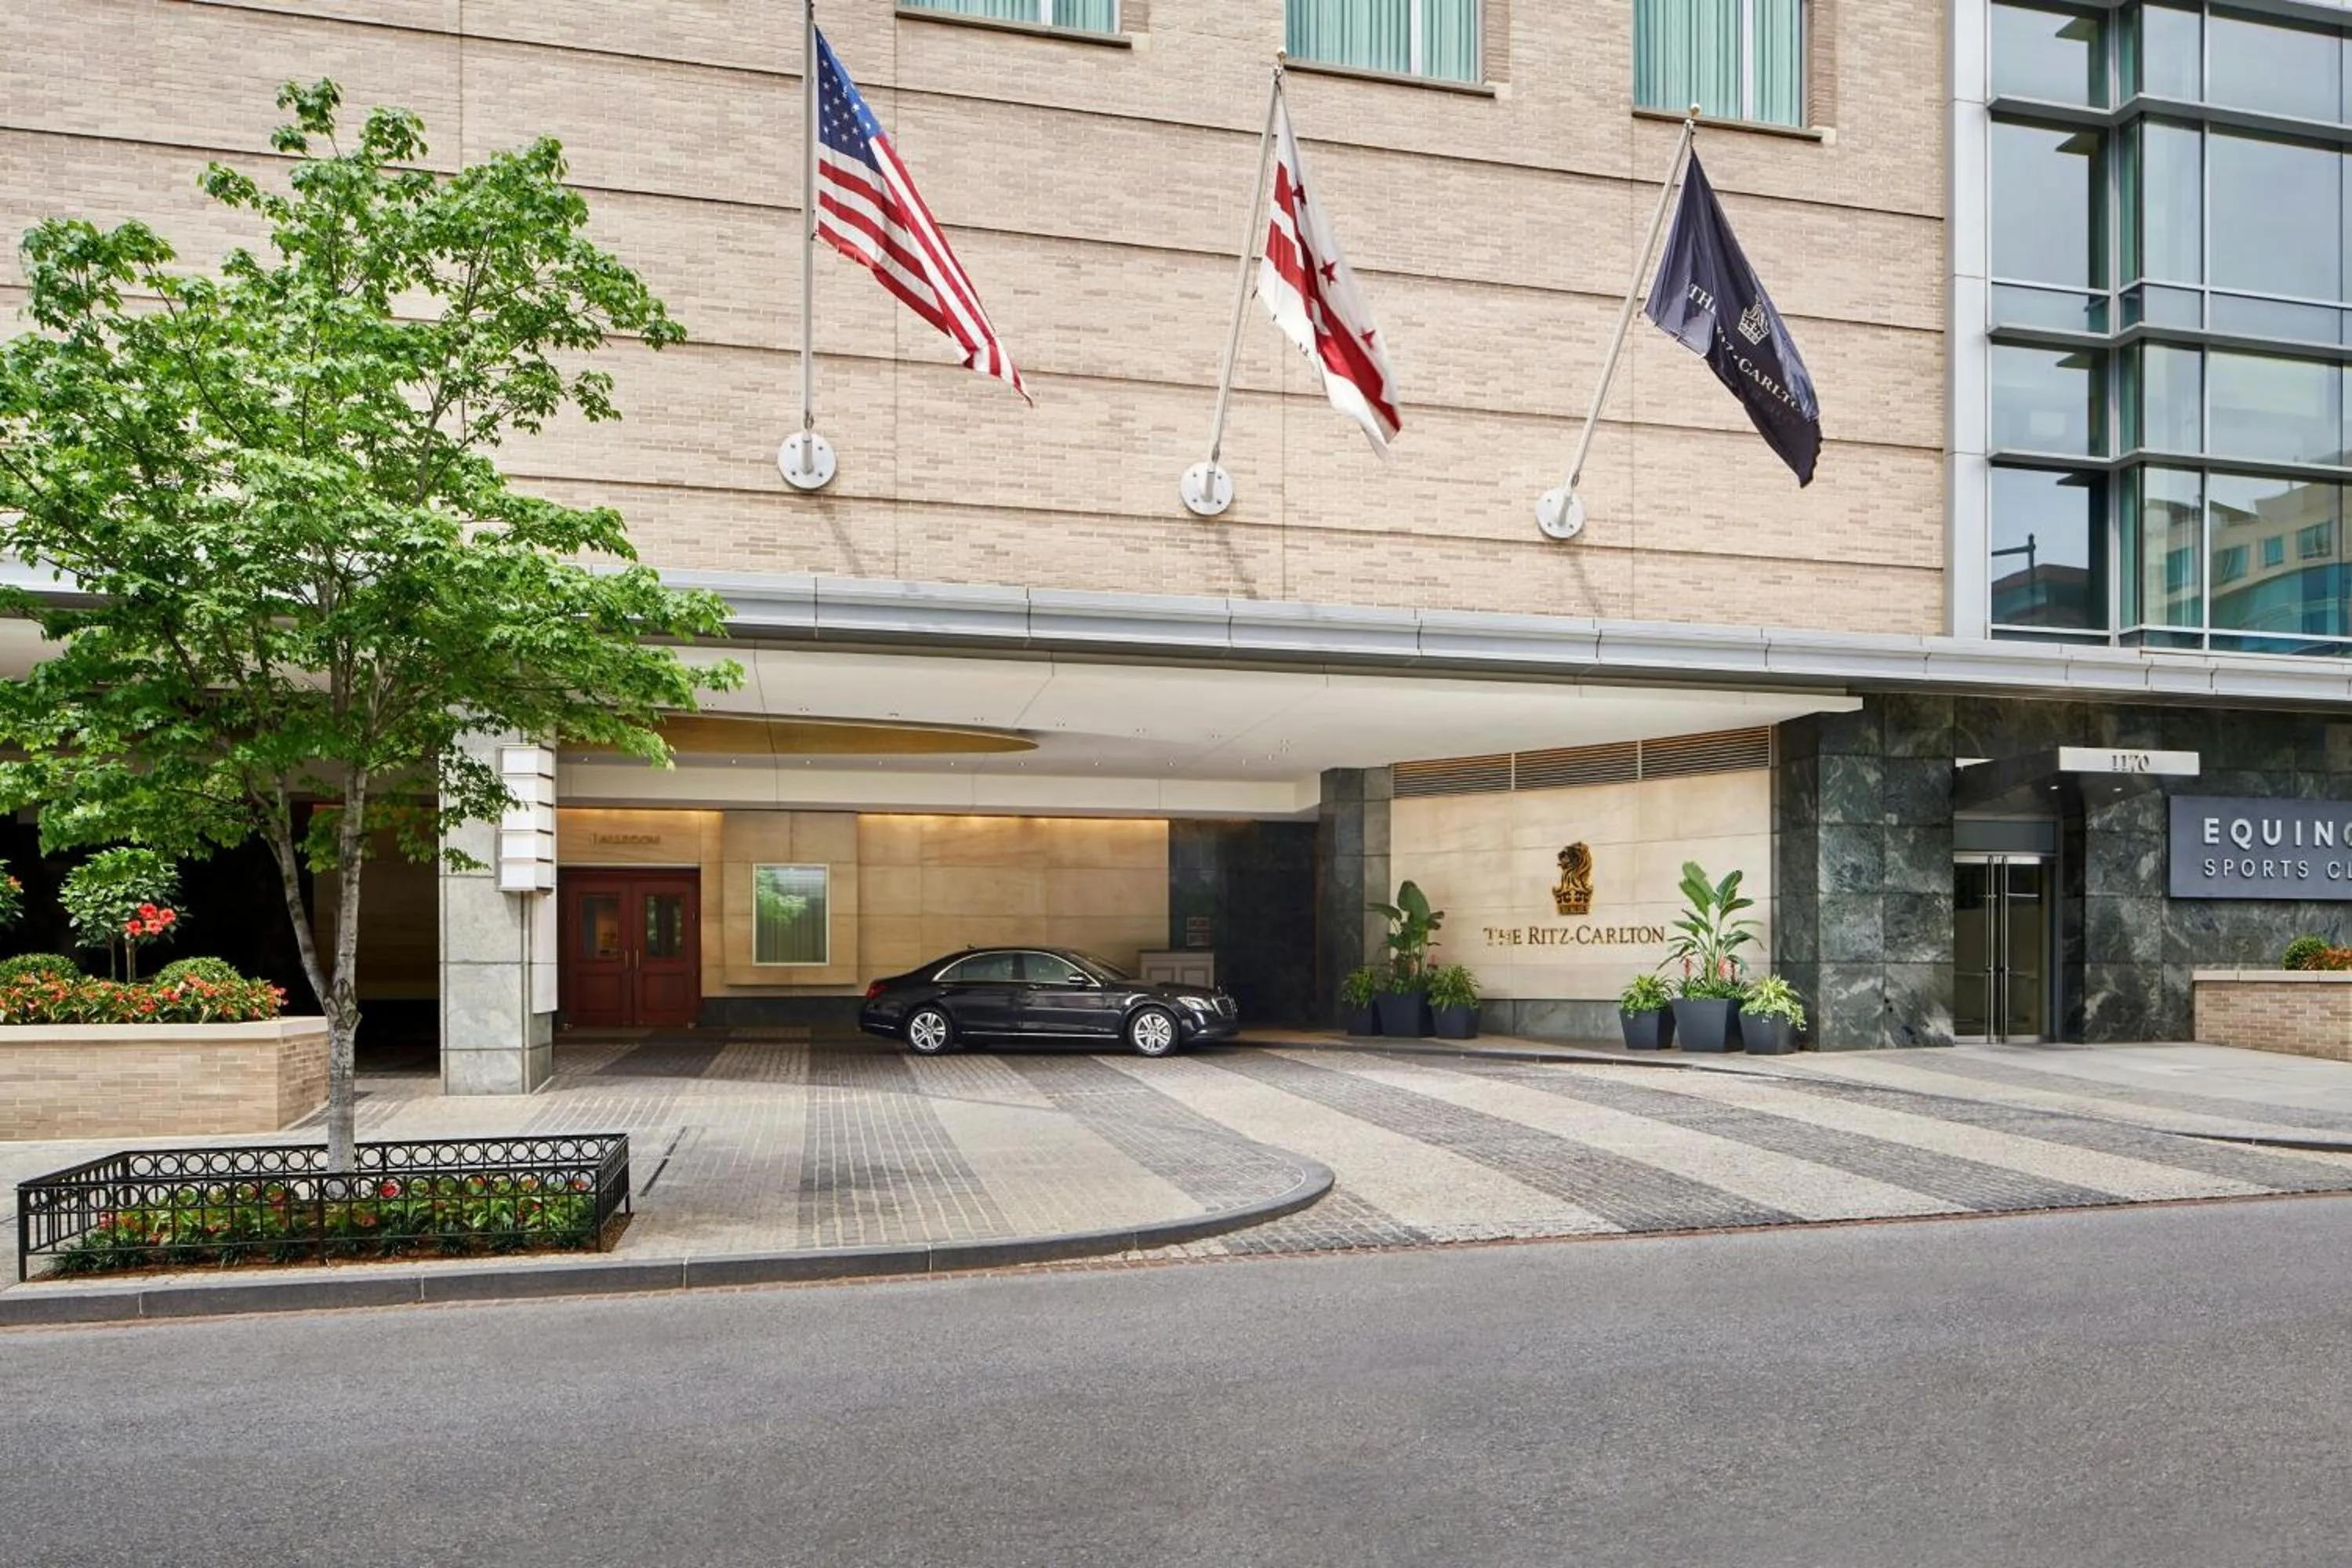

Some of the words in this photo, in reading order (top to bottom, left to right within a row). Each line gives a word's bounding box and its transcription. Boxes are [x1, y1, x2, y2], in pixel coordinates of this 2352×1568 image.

[2111, 753, 2150, 772] 1170
[2204, 859, 2309, 878] SPORTS
[1483, 927, 1522, 946] THE
[1529, 924, 1665, 945] RITZ-CARLTON
